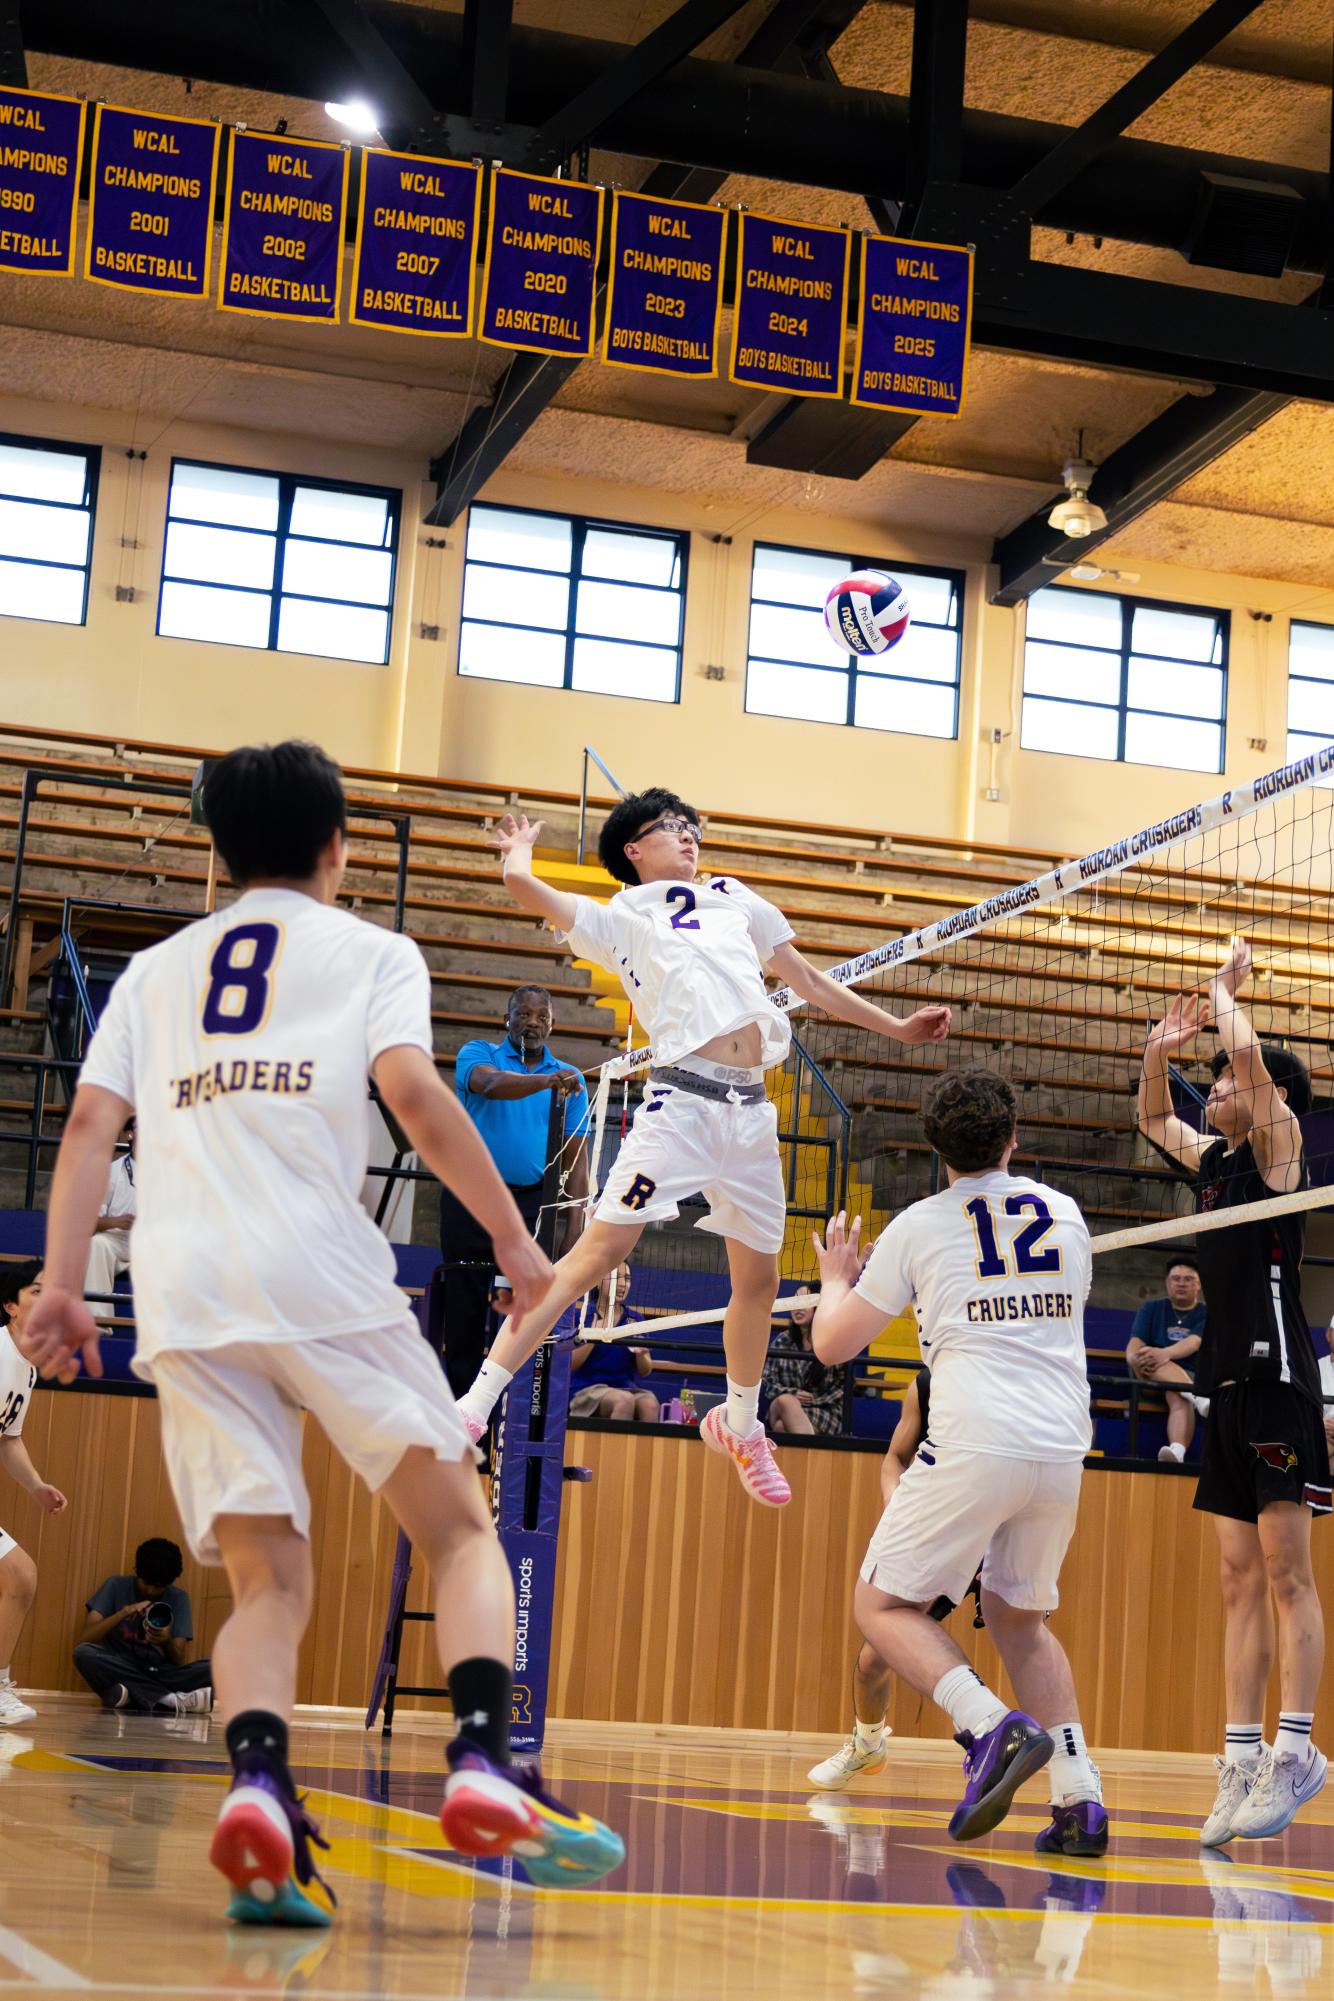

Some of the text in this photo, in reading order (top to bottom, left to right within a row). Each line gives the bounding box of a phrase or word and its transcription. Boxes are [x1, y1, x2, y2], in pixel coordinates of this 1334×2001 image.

[0, 105, 46, 131] WCAL
[133, 129, 180, 154] WCAL
[104, 165, 201, 198] CHAMPIONS
[267, 154, 313, 179] WCAL
[400, 172, 445, 197] WCAL
[0, 188, 35, 212] 990
[240, 191, 333, 223] CHAMPIONS
[528, 193, 573, 218] WCAL
[130, 211, 169, 236] 2001
[374, 207, 466, 239] CHAMPIONS
[649, 215, 691, 239] WCAL
[0, 229, 62, 256] ETBALL
[262, 235, 306, 260] 2002
[502, 226, 592, 259] CHAMPIONS
[772, 235, 814, 260] WCAL
[96, 247, 197, 281] BASKETBALL
[396, 252, 440, 276] 2007
[623, 249, 712, 281] CHAMPIONS
[896, 258, 939, 281] WCAL
[230, 273, 331, 303] BASKETBALL
[524, 271, 567, 294] 2020
[746, 269, 832, 300] CHAMPIONS
[363, 289, 462, 320] BASKETBALL
[645, 293, 685, 318] 2023
[871, 294, 960, 323] CHAMPIONS
[495, 308, 581, 341] BASKETBALL
[769, 312, 808, 337] 2024
[612, 328, 710, 360] BOYS BASKETBALL
[894, 336, 935, 358] 2025
[738, 348, 832, 380] BOYS BASKETBALL
[863, 371, 957, 401] BOYS BASKETBALL
[841, 606, 868, 651] molten
[859, 606, 880, 643] Pro Touch
[855, 939, 904, 976] CRUSADERS
[936, 907, 978, 941] RIORDAN
[980, 880, 1040, 922] CRUSADERS
[1079, 838, 1128, 879] RIORDAN
[1132, 804, 1202, 855] CRUSADERS
[1222, 791, 1232, 814] R
[1253, 755, 1315, 802] RIORDAN
[666, 886, 700, 929] 2
[200, 918, 287, 1040] 8
[170, 1060, 314, 1108] RADERS
[621, 1173, 656, 1210] R
[962, 1191, 1063, 1280] 12
[535, 1344, 545, 1368] orts
[515, 1557, 533, 1671] sports imports
